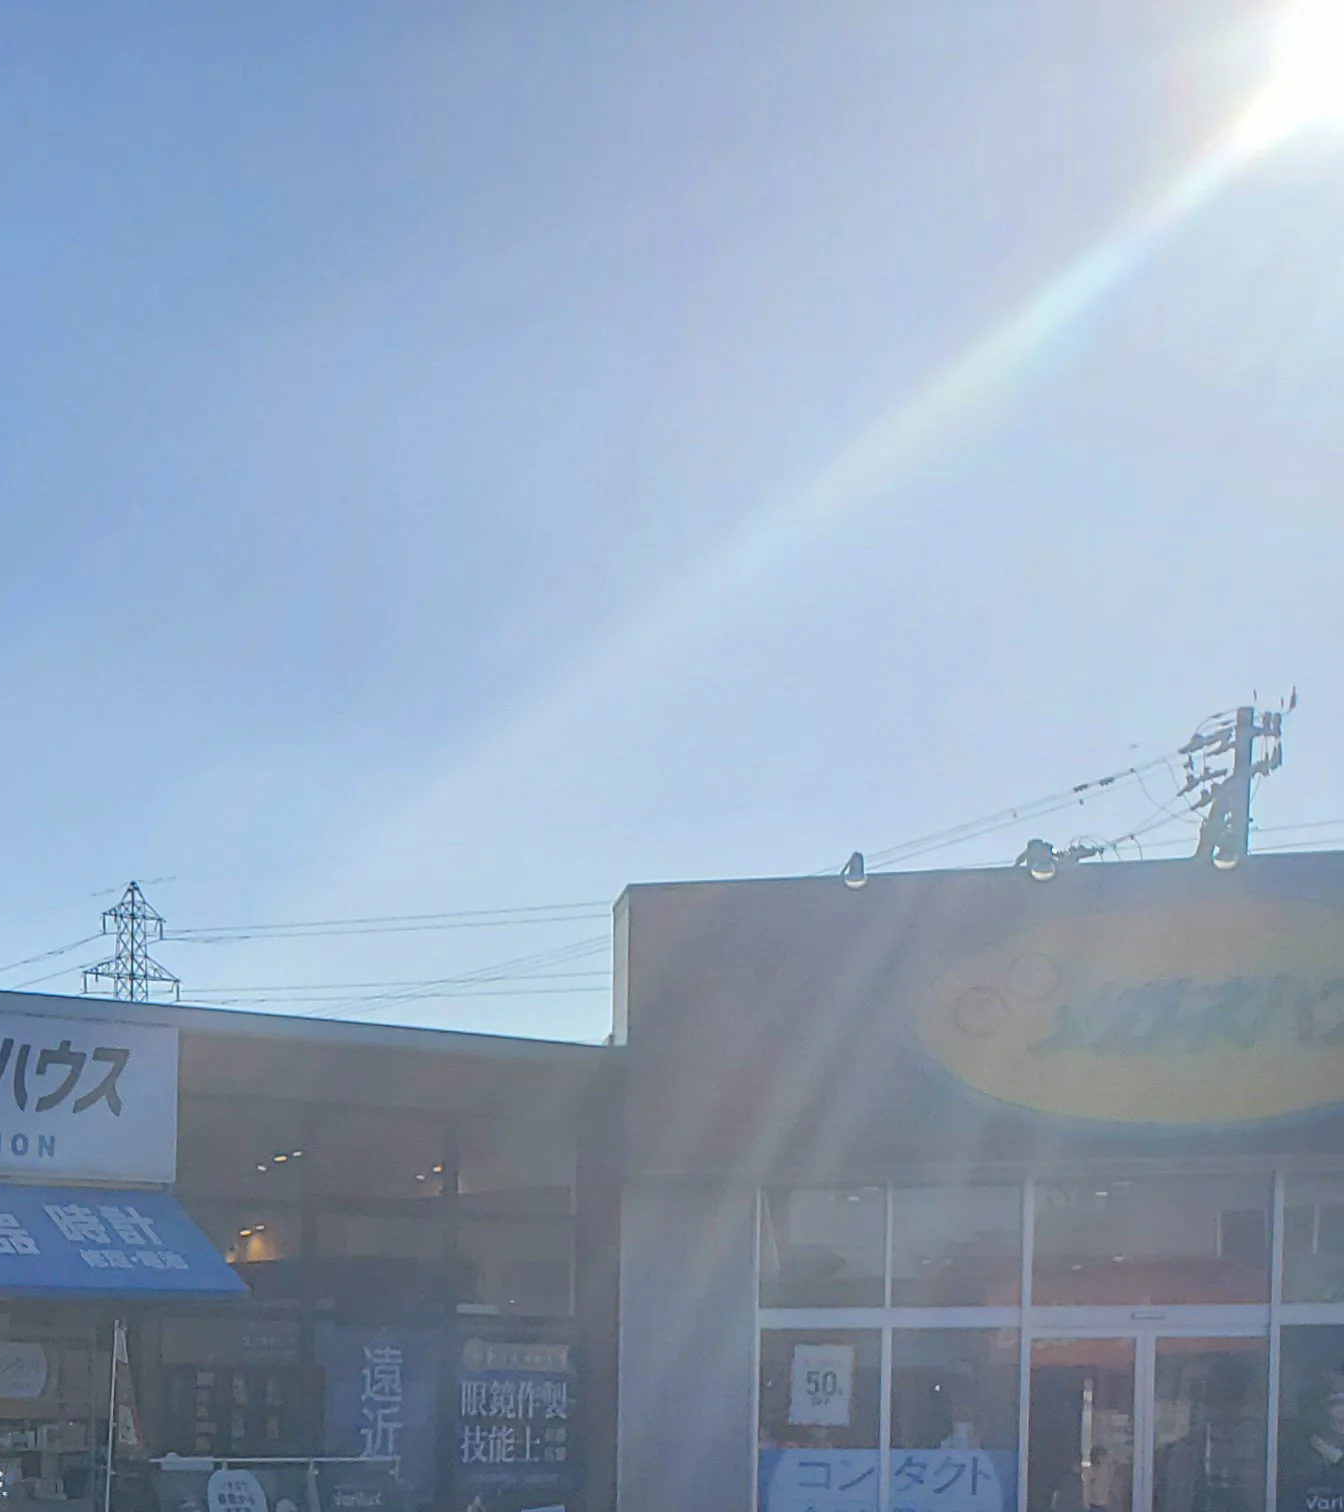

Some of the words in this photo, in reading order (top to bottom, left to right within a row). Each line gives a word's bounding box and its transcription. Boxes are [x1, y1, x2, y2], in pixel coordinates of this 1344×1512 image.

[43, 1203, 164, 1246] 時計
[360, 1344, 404, 1461] 遠近
[798, 1454, 992, 1497] コンタクト
